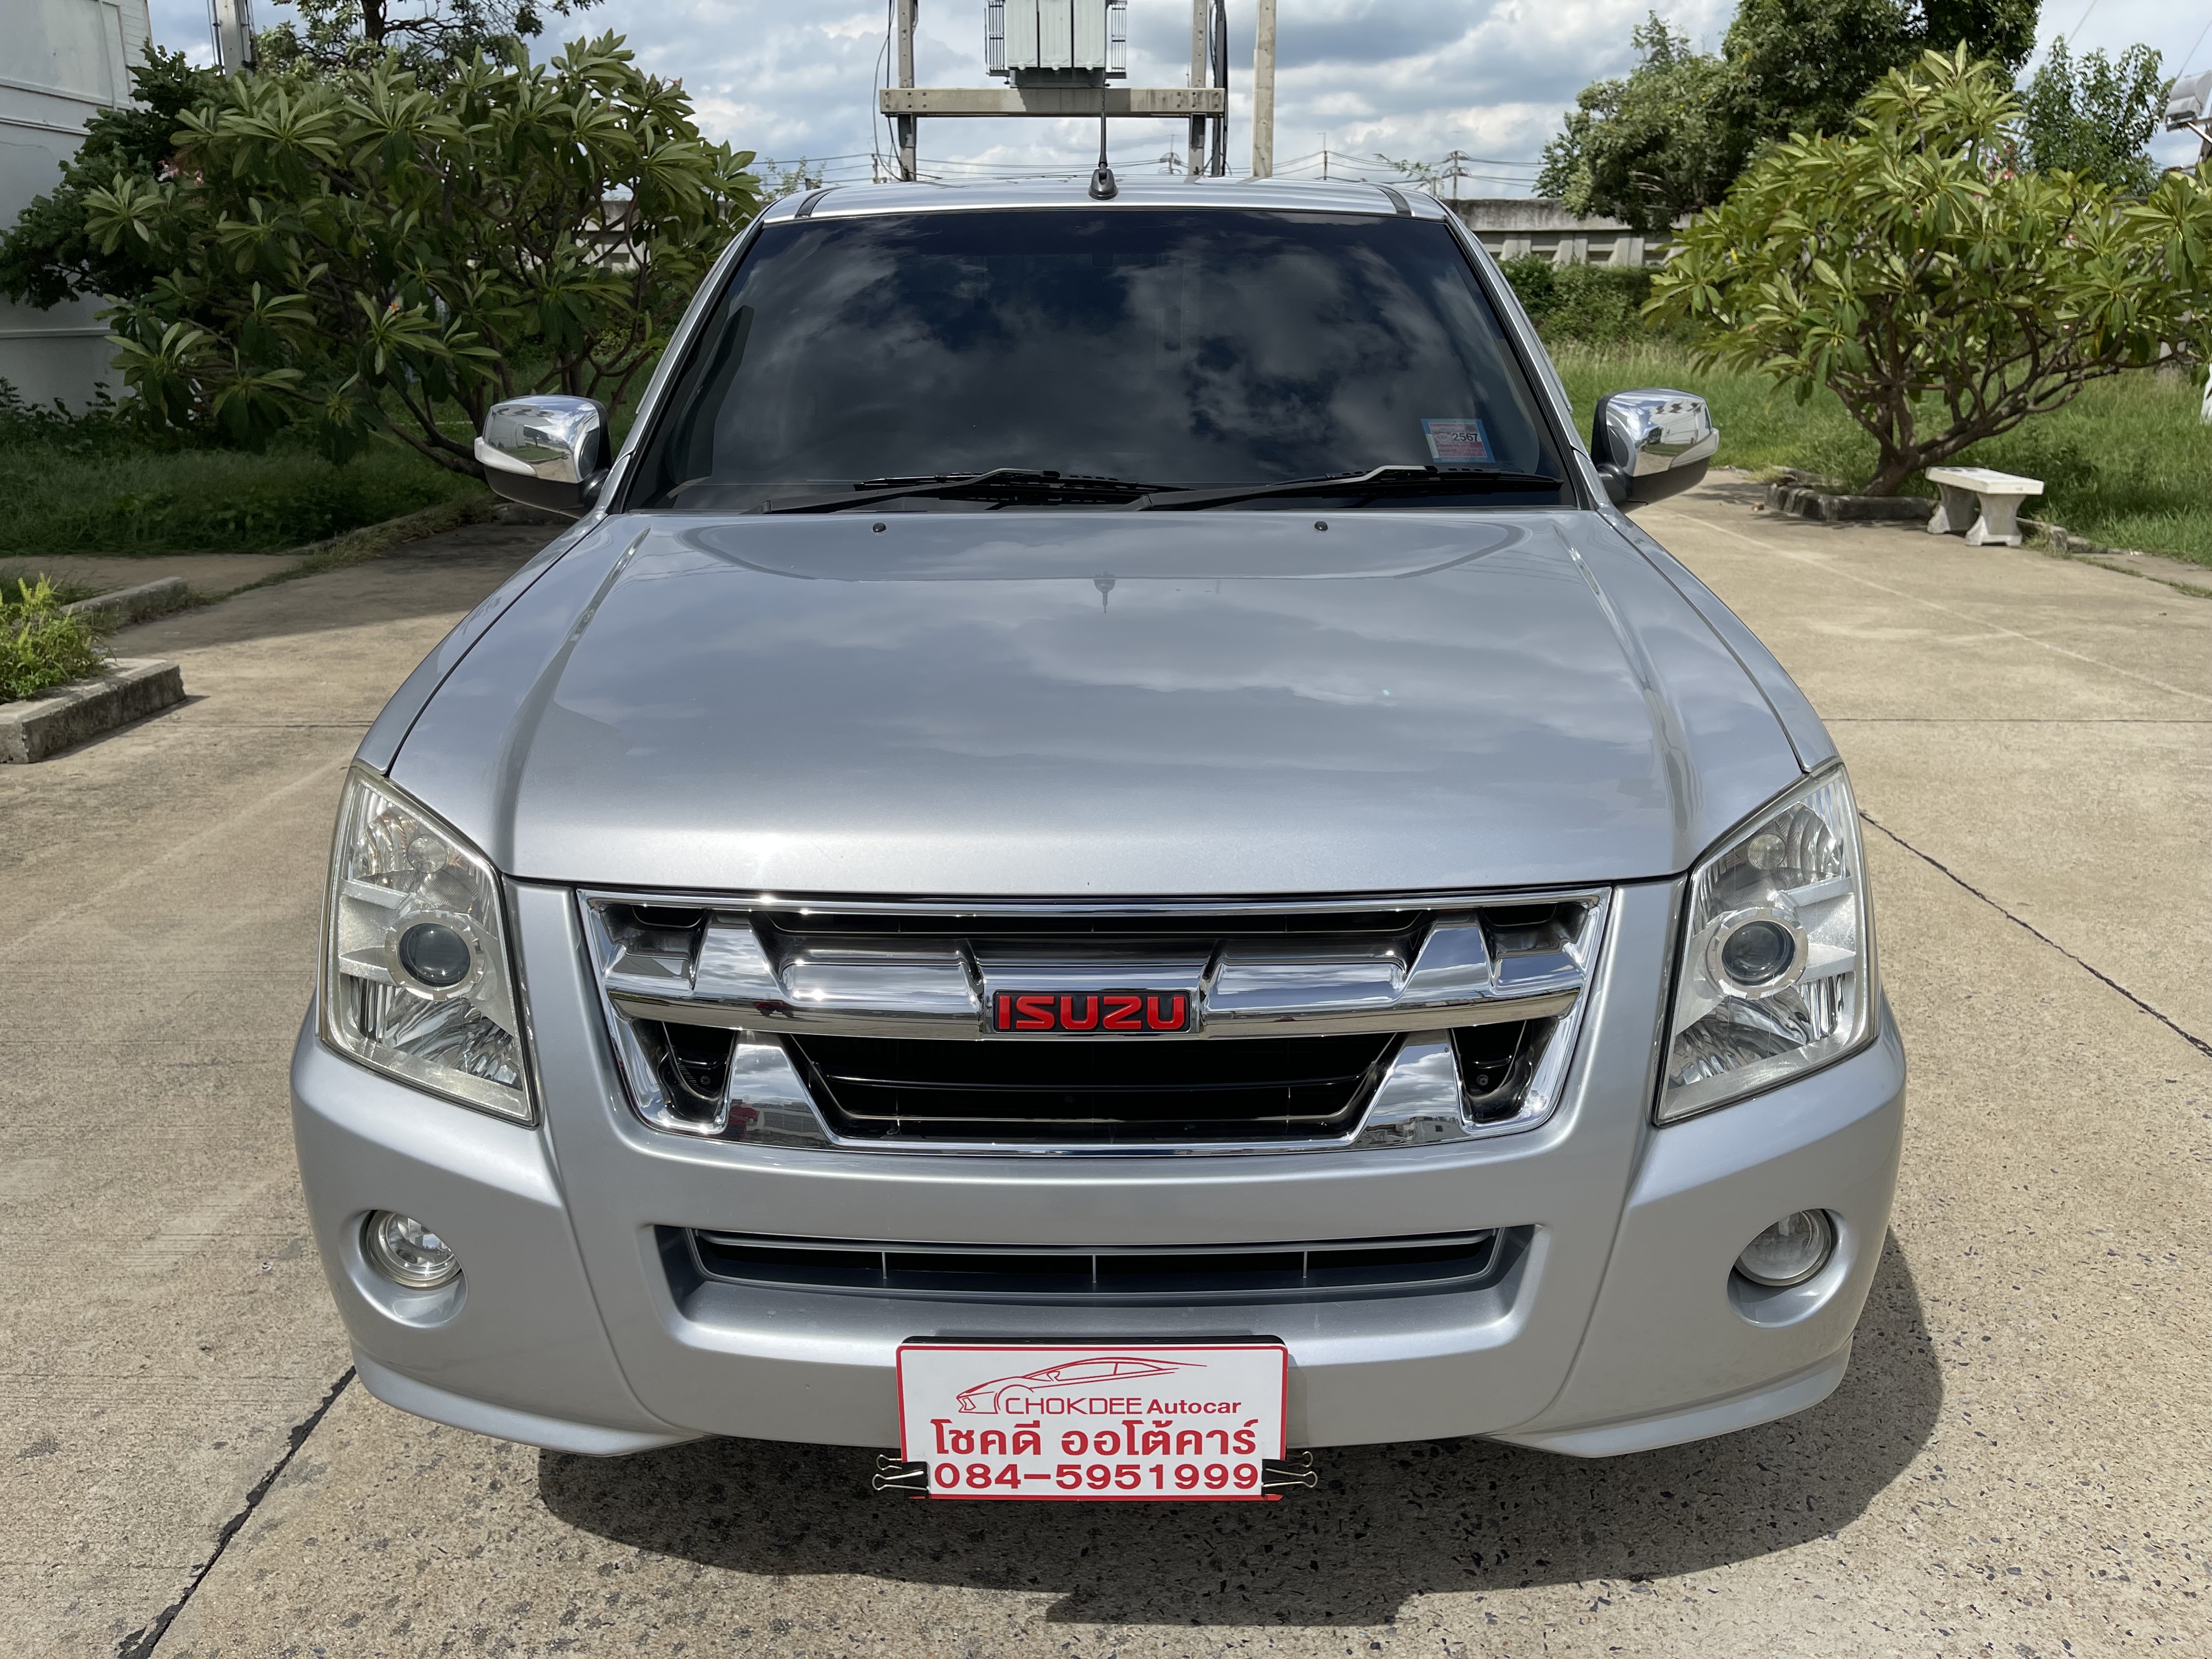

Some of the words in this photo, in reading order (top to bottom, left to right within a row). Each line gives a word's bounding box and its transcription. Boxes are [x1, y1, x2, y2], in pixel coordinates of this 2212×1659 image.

[1452, 433, 1478, 442] 2567
[998, 995, 1186, 1030] ISUZU
[1005, 1397, 1142, 1415] CHOKDEE
[1147, 1398, 1242, 1414] Autocar
[930, 1419, 1041, 1455] โชคดี
[1061, 1419, 1259, 1456] ออโต้คาร์
[934, 1462, 1259, 1490] 084-5951999
